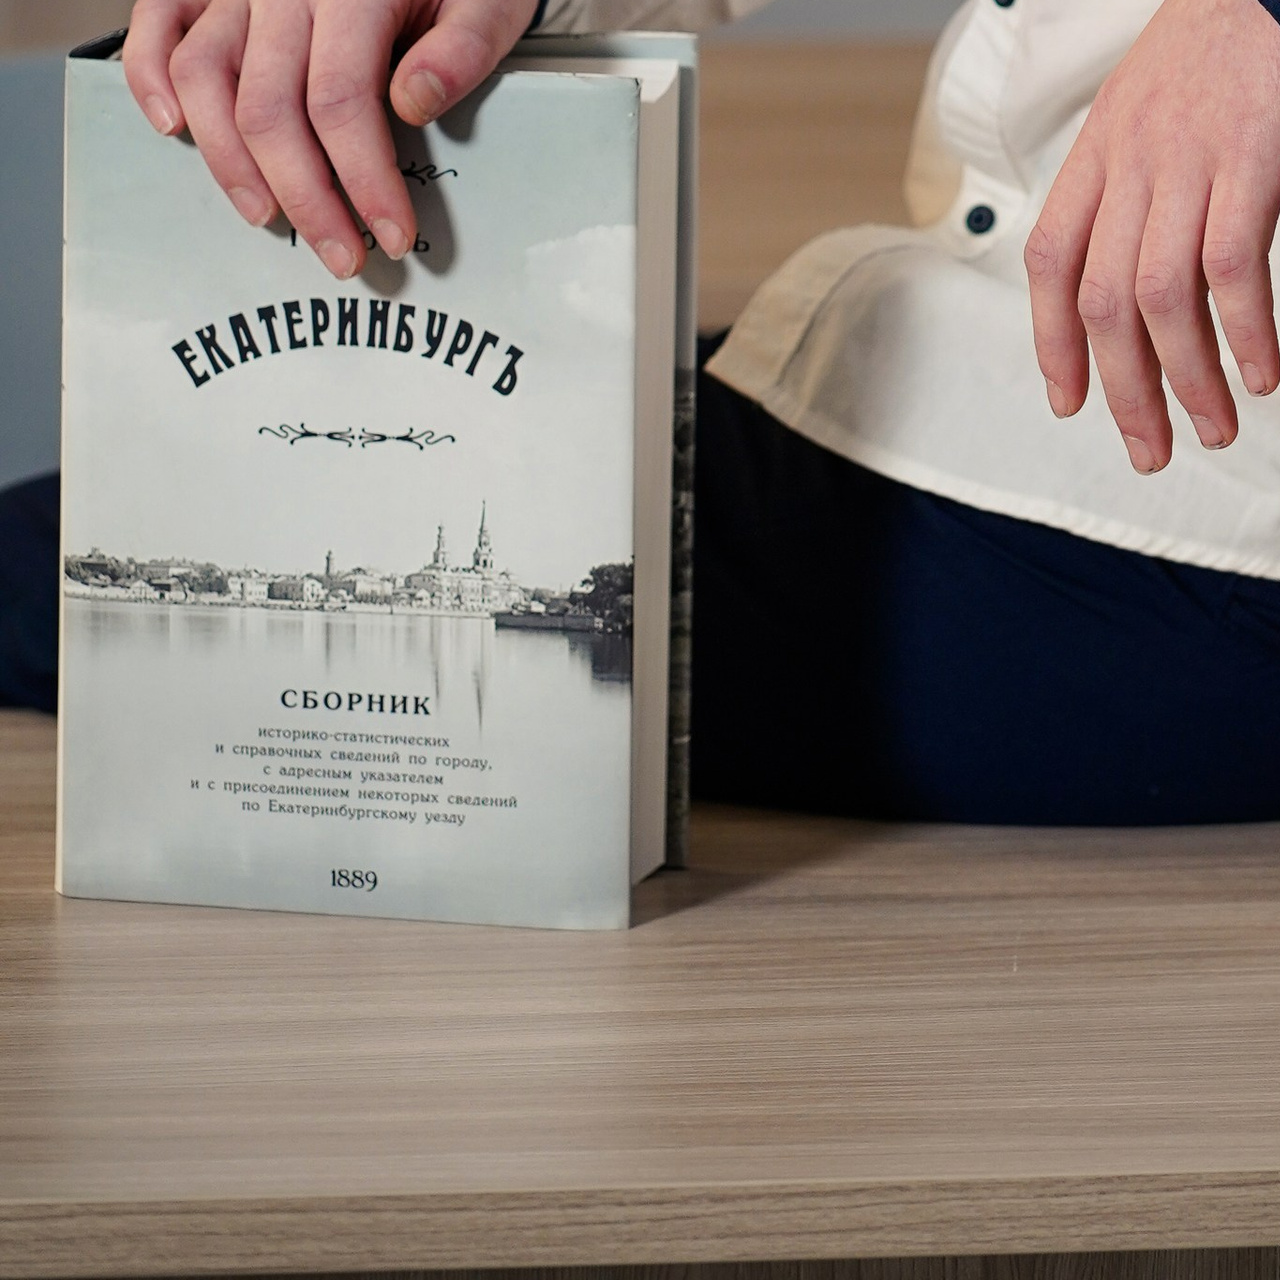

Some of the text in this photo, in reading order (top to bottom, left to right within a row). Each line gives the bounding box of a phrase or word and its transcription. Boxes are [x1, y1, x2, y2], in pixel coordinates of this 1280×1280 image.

[171, 297, 525, 397] ЕКАТЕРИНБУРГЪ
[280, 689, 431, 716] СБОРНИК
[258, 727, 450, 747] историко-статистических
[215, 743, 224, 754] и
[232, 744, 322, 760] справочных
[330, 749, 401, 764] сведений
[408, 754, 427, 765] по
[263, 765, 444, 785] с адресным указателем
[190, 779, 518, 809] и с присоединением некоторых сведений
[242, 799, 466, 826] по Екатеринбургскому уезду
[331, 868, 378, 892] 1889
